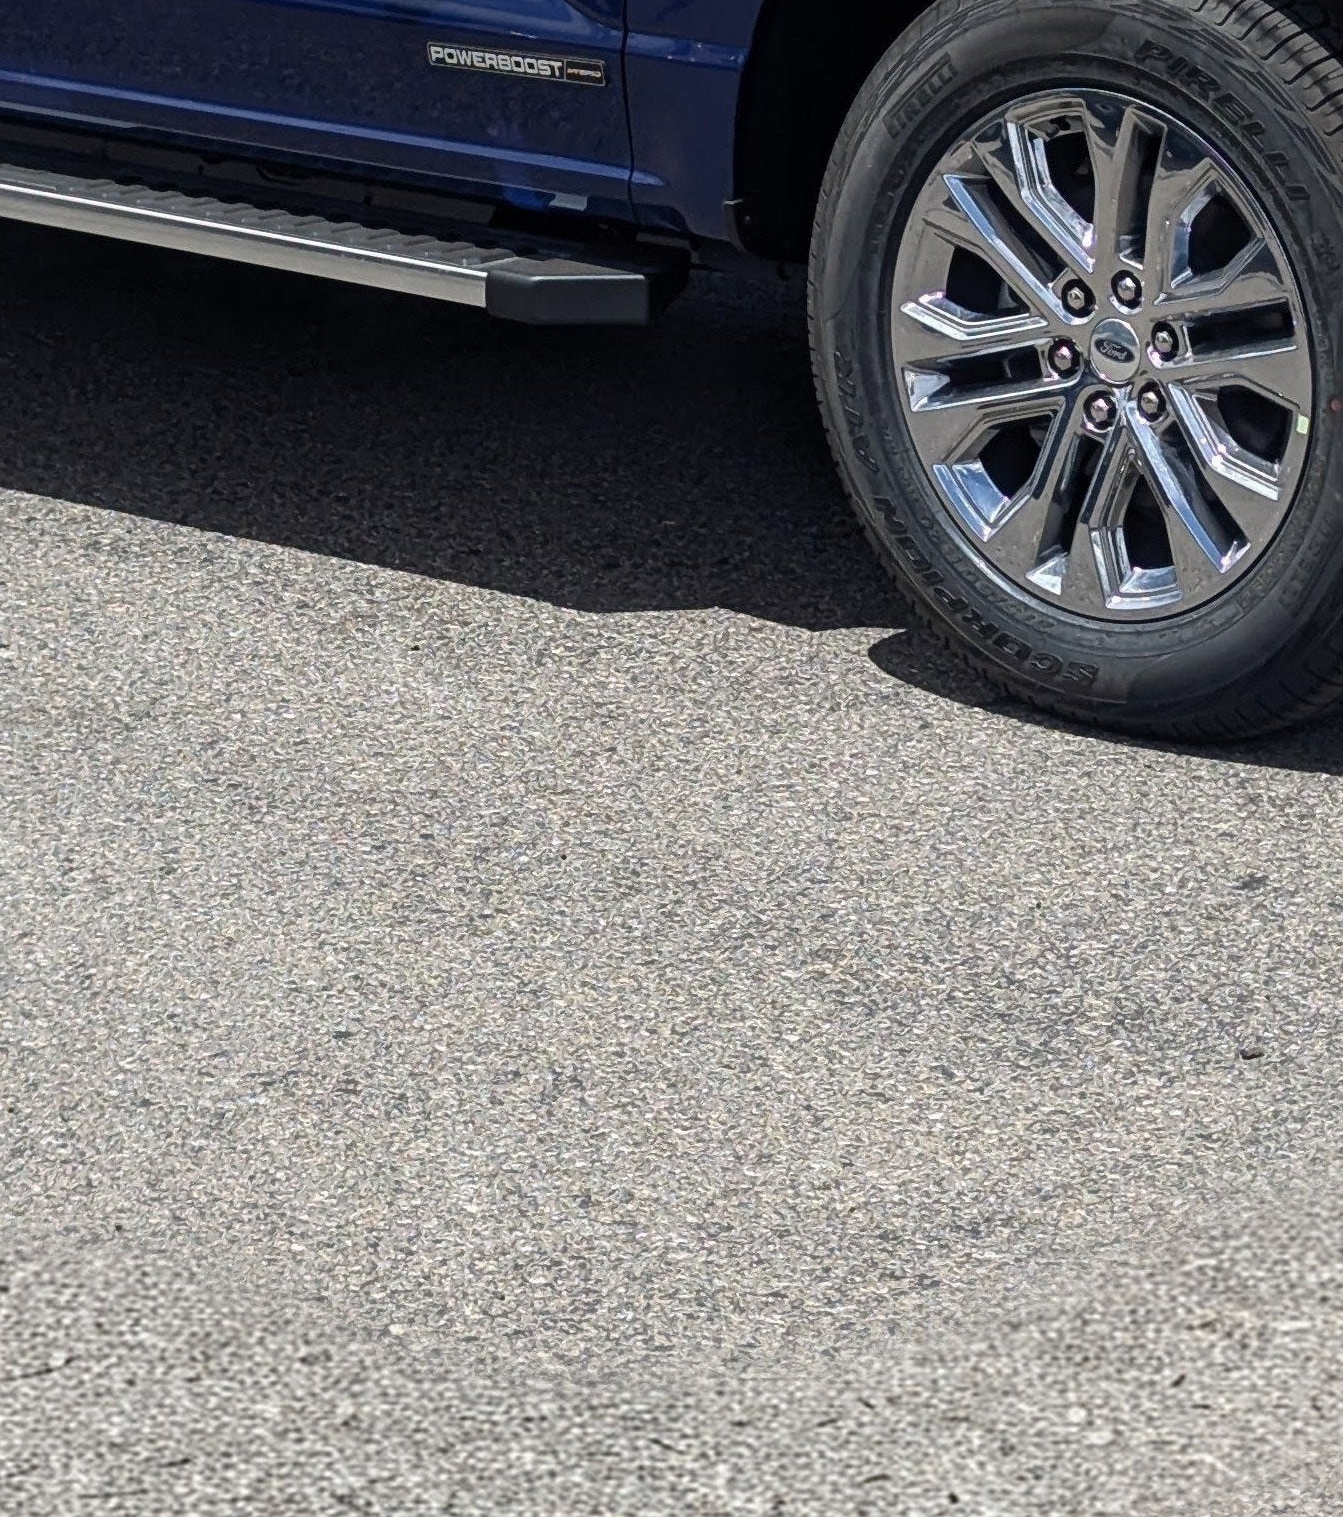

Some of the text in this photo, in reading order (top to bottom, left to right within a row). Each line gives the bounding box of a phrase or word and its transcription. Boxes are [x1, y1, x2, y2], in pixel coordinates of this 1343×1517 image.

[430, 46, 563, 77] POWERBOOST
[1134, 40, 1310, 202] PIRELLI
[1100, 341, 1127, 360] Ford
[872, 496, 1100, 683] SCORPION
